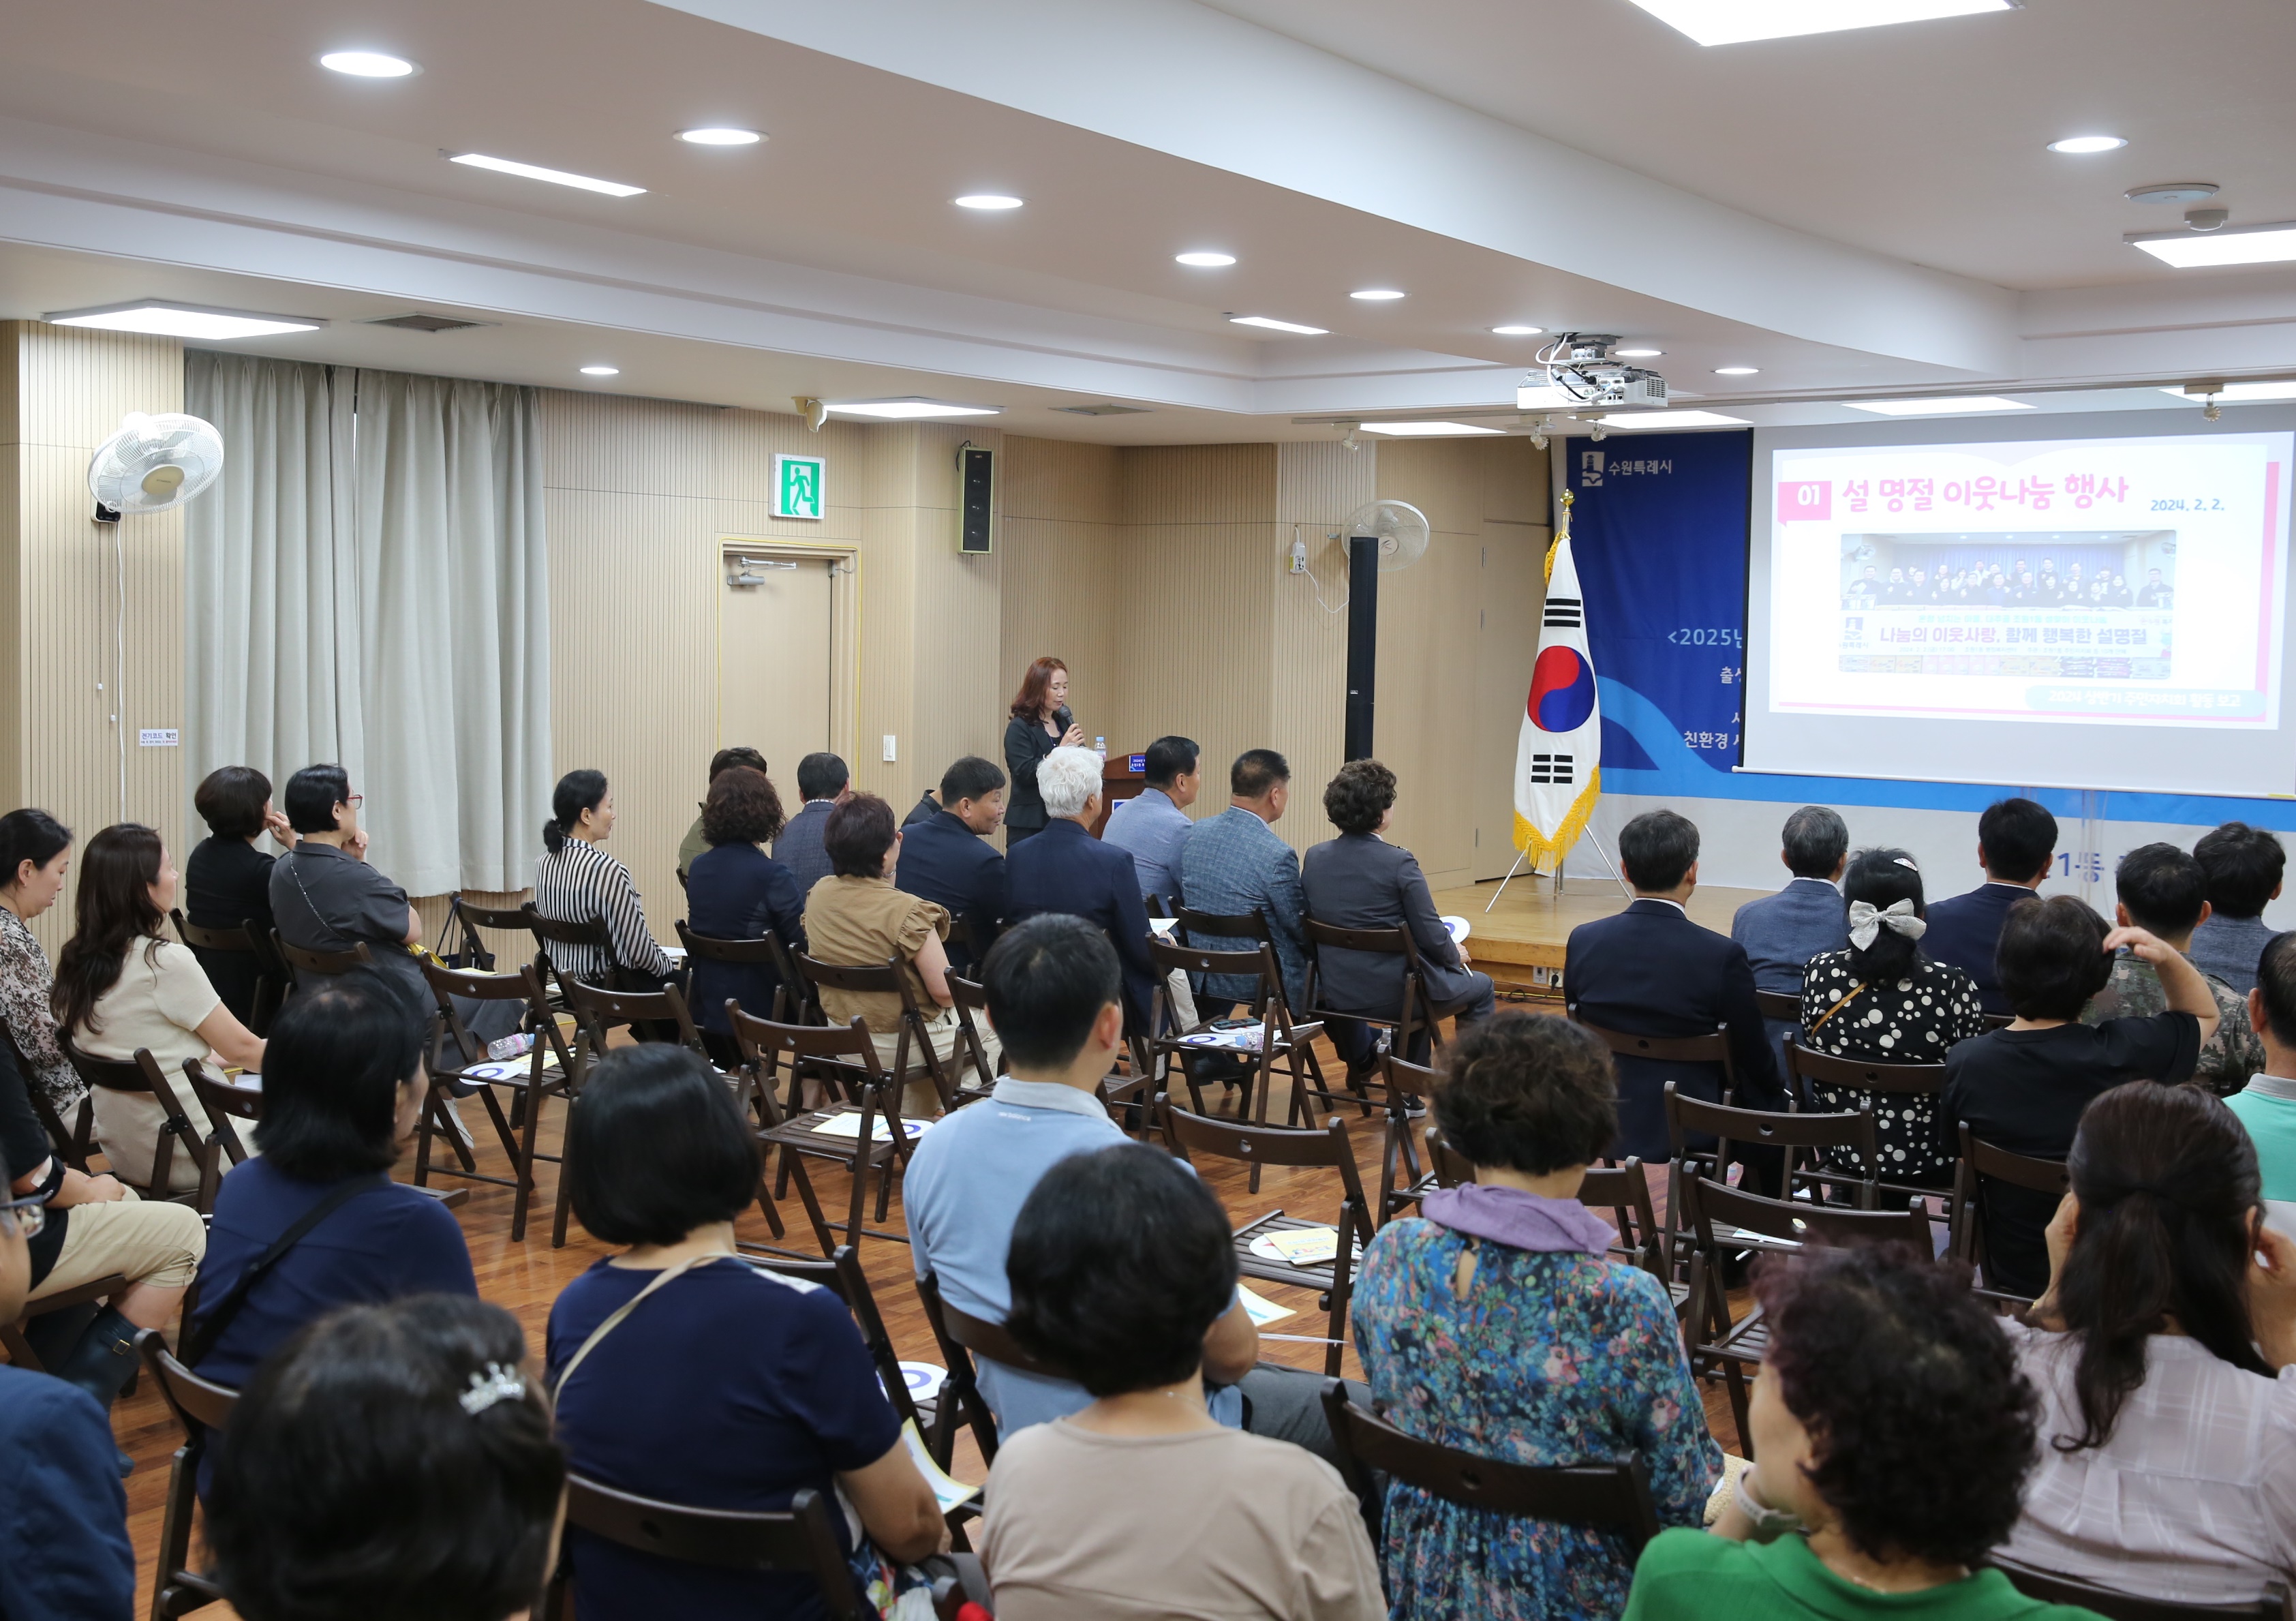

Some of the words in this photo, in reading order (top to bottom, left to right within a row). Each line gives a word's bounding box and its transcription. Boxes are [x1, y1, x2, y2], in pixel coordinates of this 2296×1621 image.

[1608, 459, 1672, 476] 수원특례시
[1797, 485, 1820, 506] 01
[1842, 479, 1869, 512] 설
[1879, 479, 1933, 512] 명절
[1943, 476, 2055, 511] 이웃나눔
[2065, 474, 2129, 509] 행사
[2151, 499, 2190, 511] 2024.
[2194, 498, 2207, 511] 2.
[2211, 498, 2224, 511] 2.
[1880, 627, 1927, 643] 나눔의
[2006, 627, 2037, 643] 함께
[2042, 627, 2092, 644] 행복한
[2097, 628, 2147, 645] 설명절
[2048, 690, 2082, 702] 2024
[2084, 690, 2122, 705] 상반기
[2124, 691, 2186, 706] 주민자치회
[2217, 694, 2241, 707] 보고
[1684, 731, 1728, 749] 친환경
